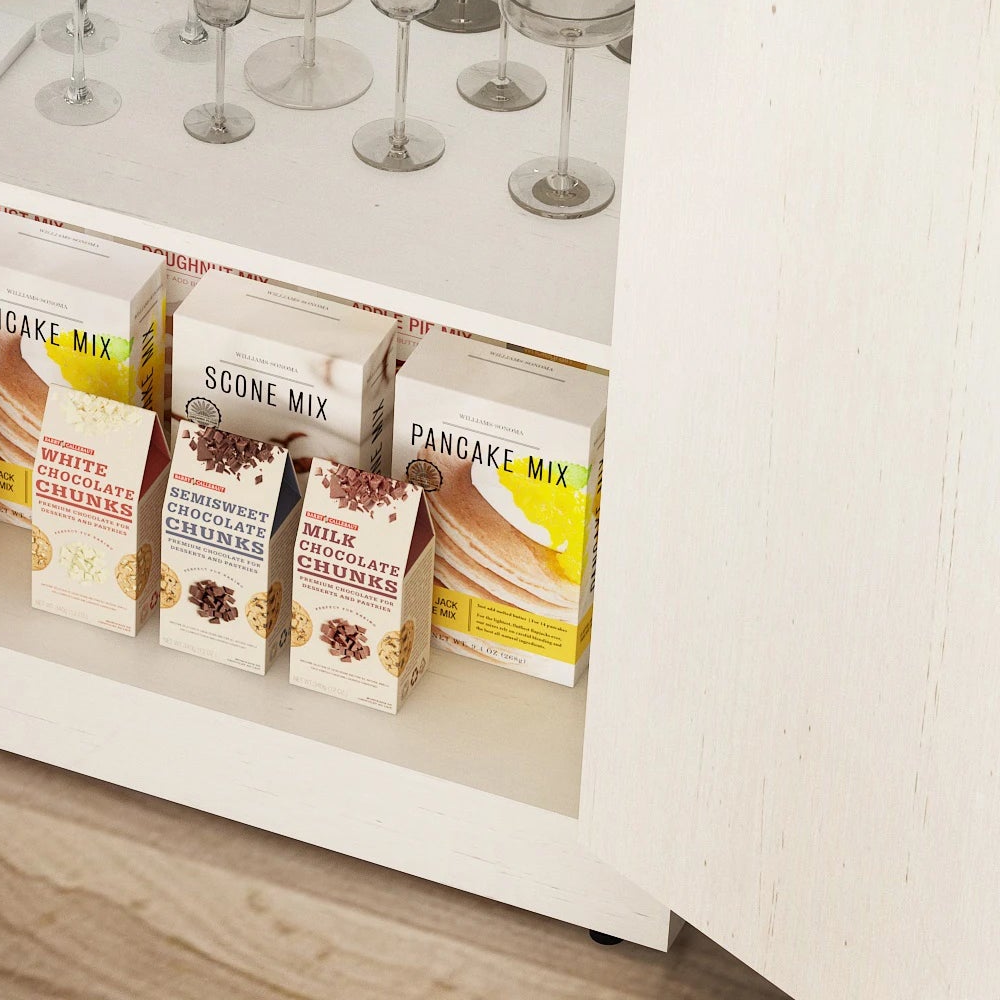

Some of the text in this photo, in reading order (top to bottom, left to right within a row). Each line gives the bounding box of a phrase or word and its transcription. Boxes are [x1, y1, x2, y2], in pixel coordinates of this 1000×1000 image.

[6, 288, 69, 310] WILLIAMS-SONOMA
[73, 329, 111, 360] MIX
[235, 351, 299, 373] WILLIAMS-SONOMA
[205, 365, 328, 421] SCONE MIX
[459, 413, 524, 436] WILLIAMS-SONOMA
[41, 446, 108, 478] WHITE
[411, 423, 514, 473] PANCAKE
[527, 455, 568, 488] MIX
[37, 464, 135, 501] CHOCOLATE
[36, 479, 133, 517] CHUNKS
[169, 486, 269, 524] SEMISWEET
[38, 500, 130, 530] PREMIUM CHOCOLATE FOR
[40, 507, 128, 536] DESSERTS AND PASTRIES
[167, 501, 267, 539] CHOCOLATE
[165, 516, 264, 555] CHUNKS
[302, 522, 356, 549] MILK
[168, 537, 261, 568] PREMIUM CHOCOLATE FOR
[170, 545, 258, 574] DESSERTS AND PASTRIES
[300, 539, 400, 578] CHOCOLATE
[297, 554, 398, 594] CHUNKS
[300, 575, 394, 607] PREMIUM CHOCOLATE FOR
[302, 583, 392, 613] DESSERTS AND PASTRIES
[435, 597, 458, 610] JACK
[440, 608, 456, 620] MIX
[496, 609, 512, 617] melted
[512, 613, 527, 621] butter
[546, 624, 568, 633] pancakes
[432, 632, 449, 642] NET
[485, 622, 499, 630] mixes
[516, 631, 532, 639] careful
[532, 636, 552, 646] blending
[501, 633, 518, 641] natural
